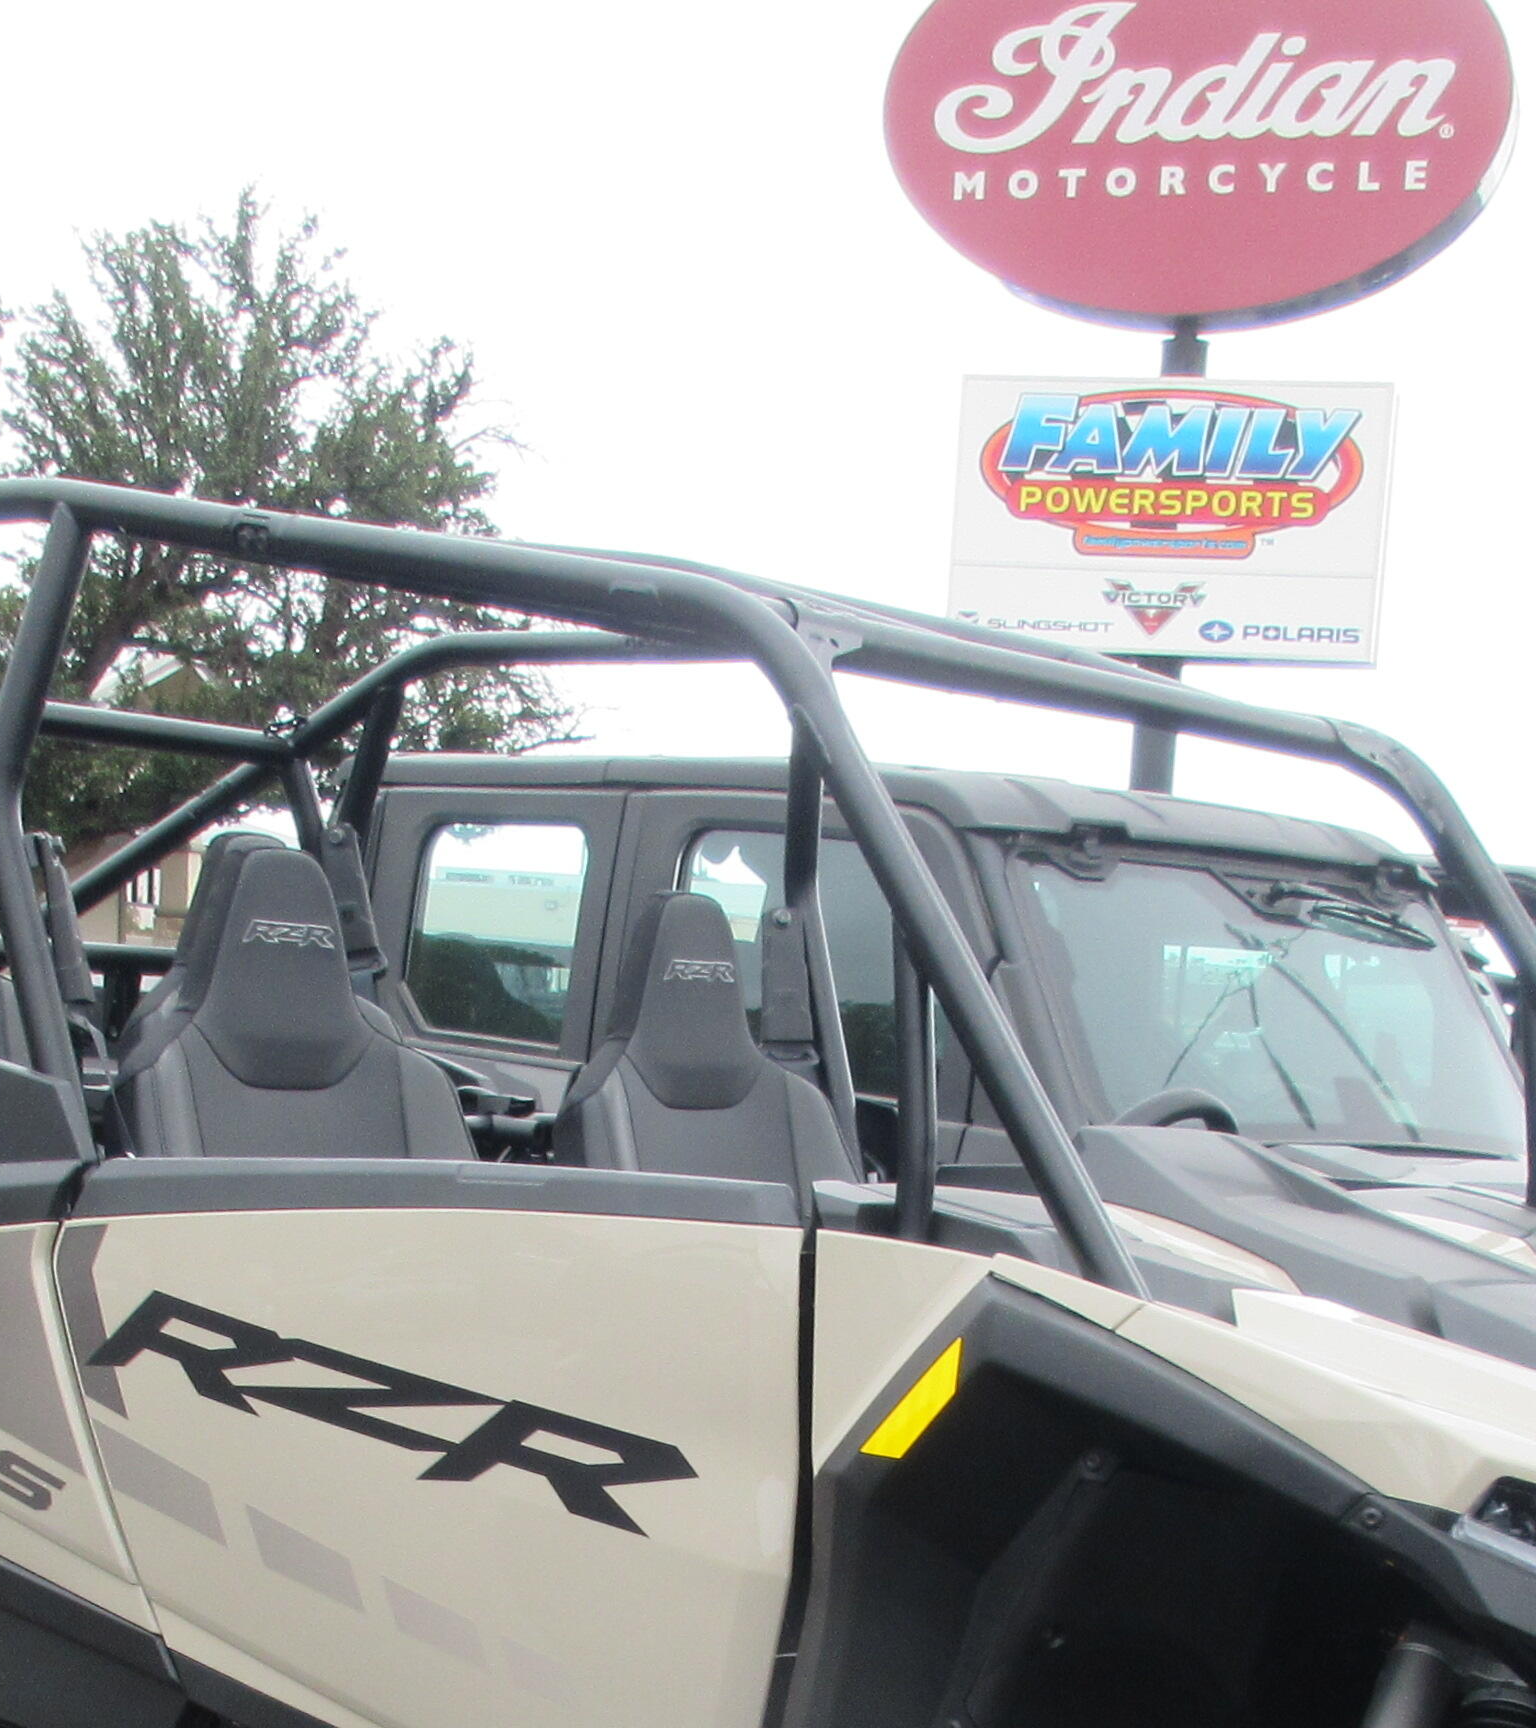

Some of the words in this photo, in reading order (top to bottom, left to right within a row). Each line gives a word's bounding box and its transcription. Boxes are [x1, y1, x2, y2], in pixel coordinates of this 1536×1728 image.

[934, 1, 1456, 154] Indian
[953, 160, 1430, 201] MOTORCYCLE
[1001, 393, 1362, 482] FAMILY
[1019, 487, 1315, 519] POWERSPORTS
[1102, 589, 1208, 607] VICTORY
[987, 618, 1114, 633] SLINGSHOT
[1243, 624, 1360, 644] POLARIS
[242, 918, 336, 951] RZR
[664, 958, 736, 984] RZR
[86, 1290, 700, 1538] RZR
